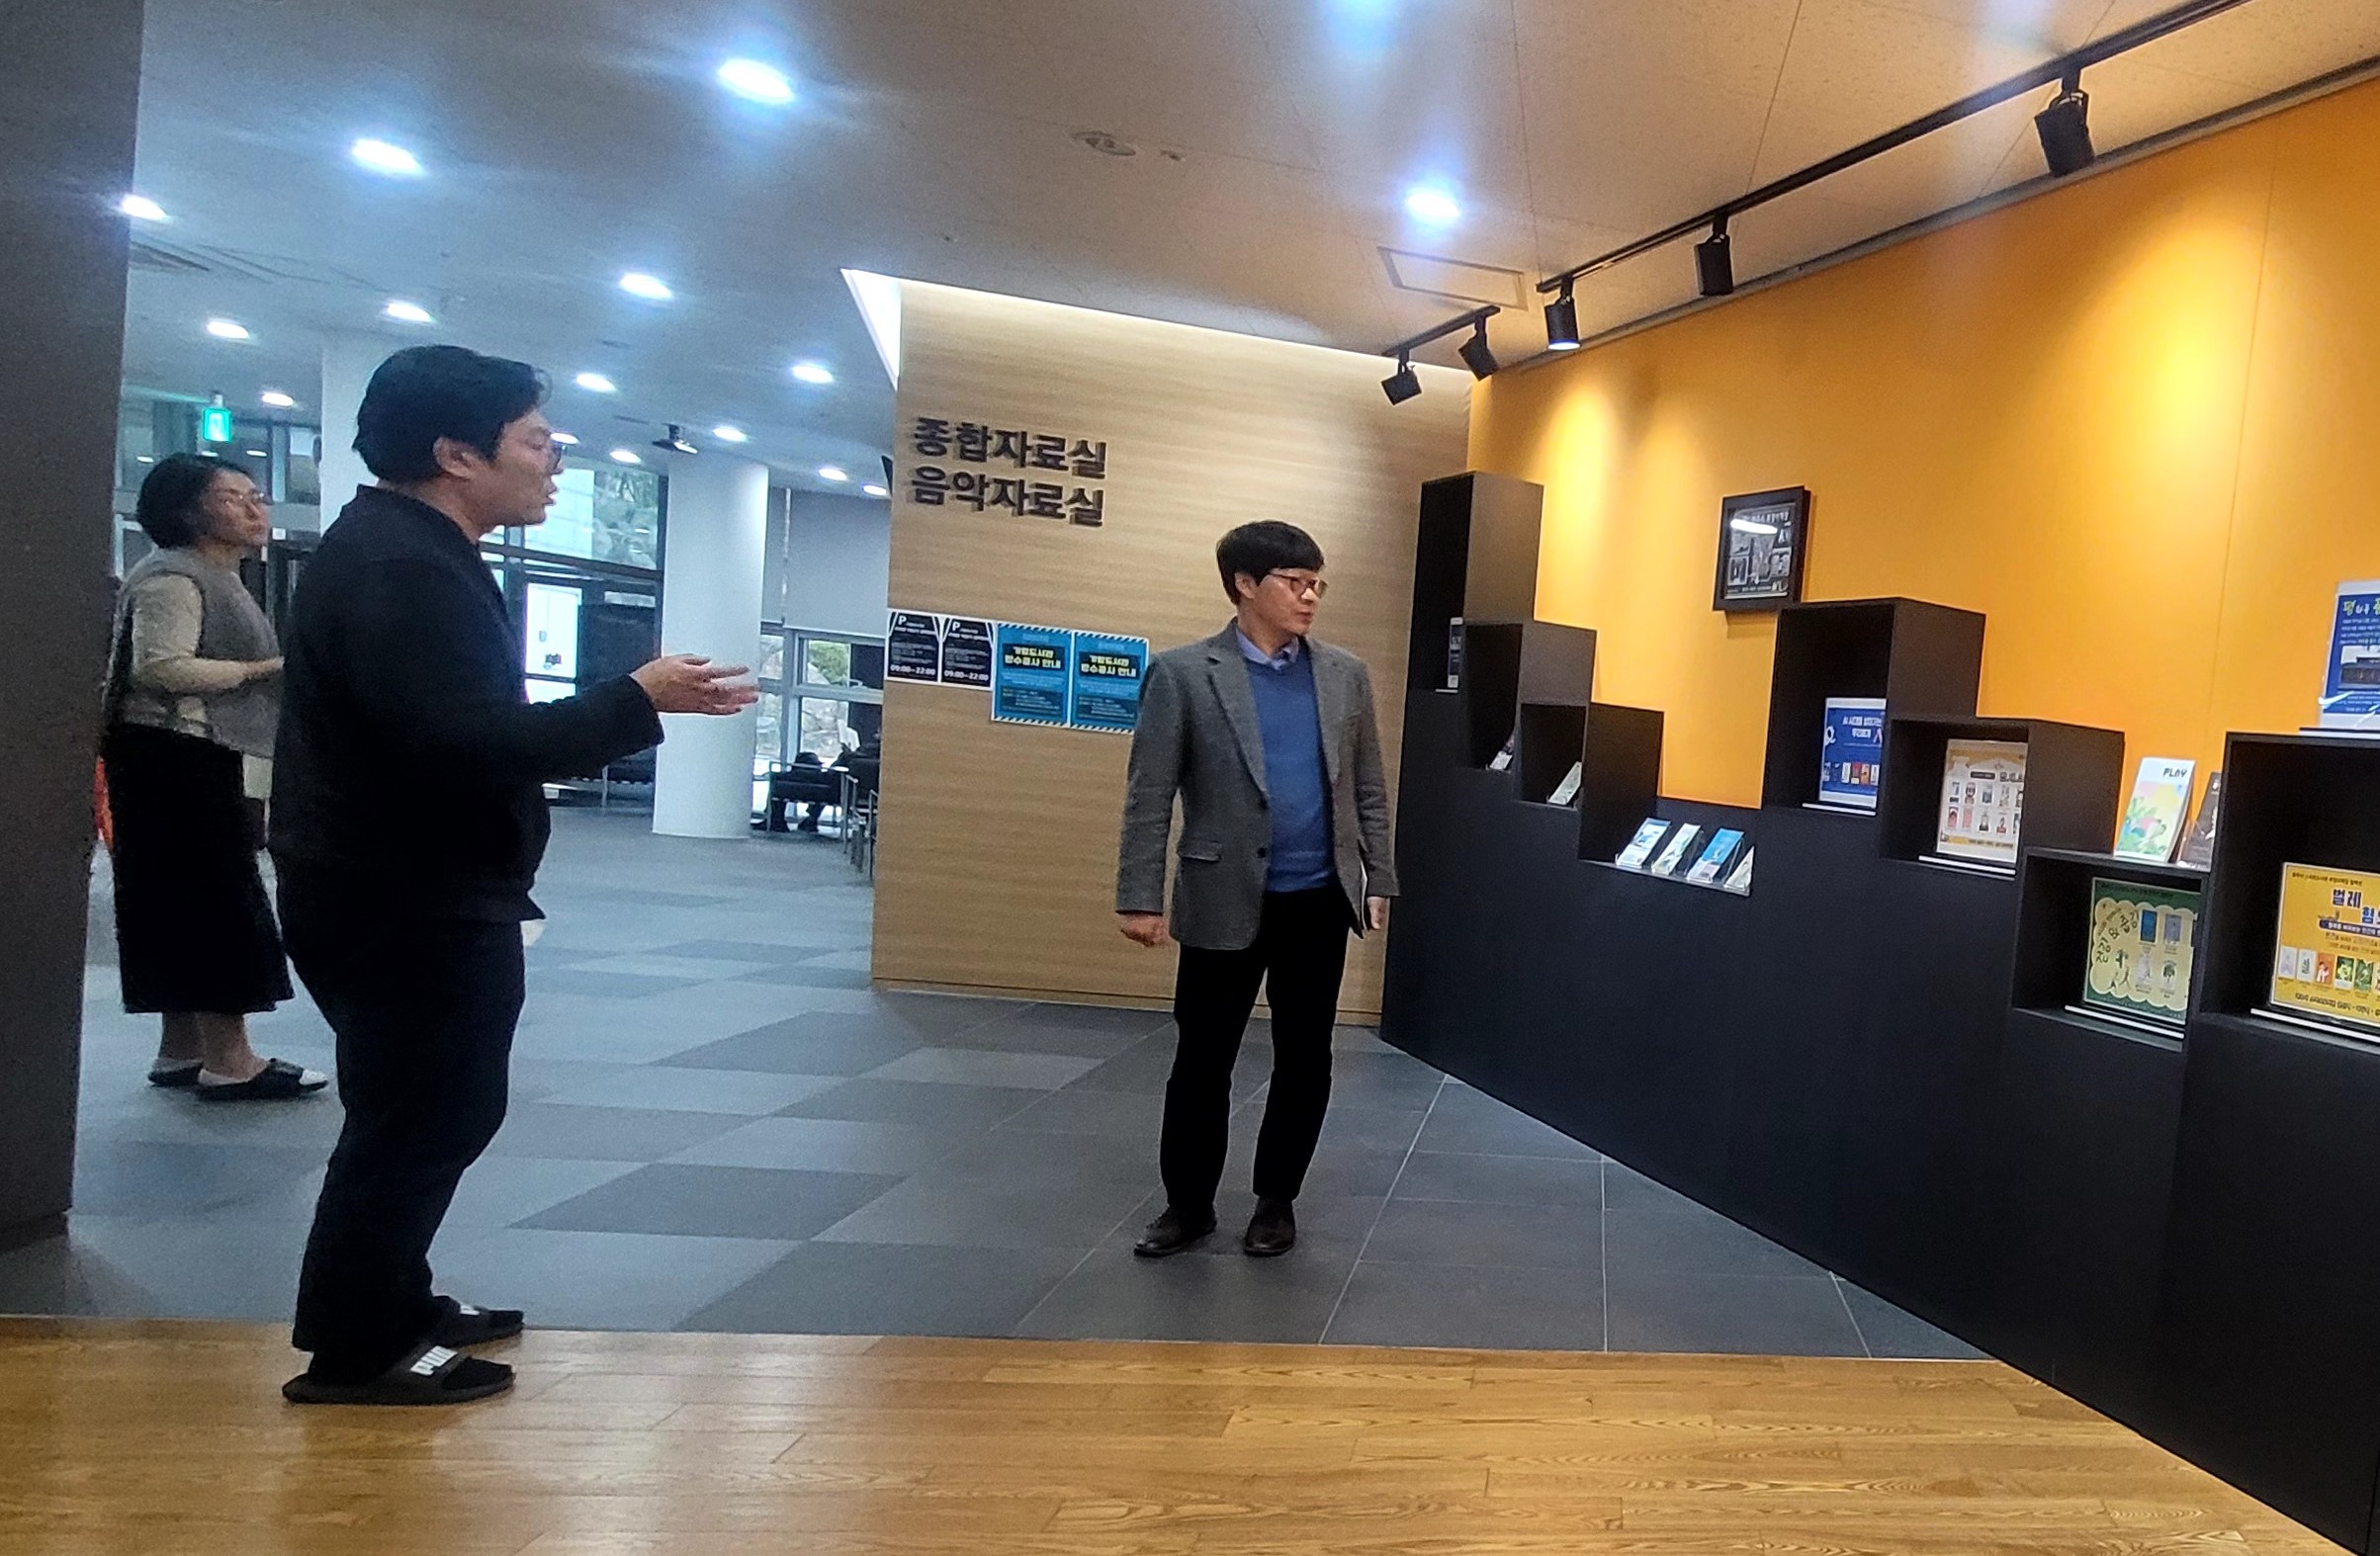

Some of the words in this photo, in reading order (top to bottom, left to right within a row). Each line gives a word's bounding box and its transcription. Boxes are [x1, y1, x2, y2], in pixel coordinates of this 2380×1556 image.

[915, 416, 1106, 479] 종합자료실
[912, 466, 1104, 527] 음악자료실
[898, 615, 907, 626] P
[952, 621, 960, 632] P
[2333, 889, 2361, 909] 벌레
